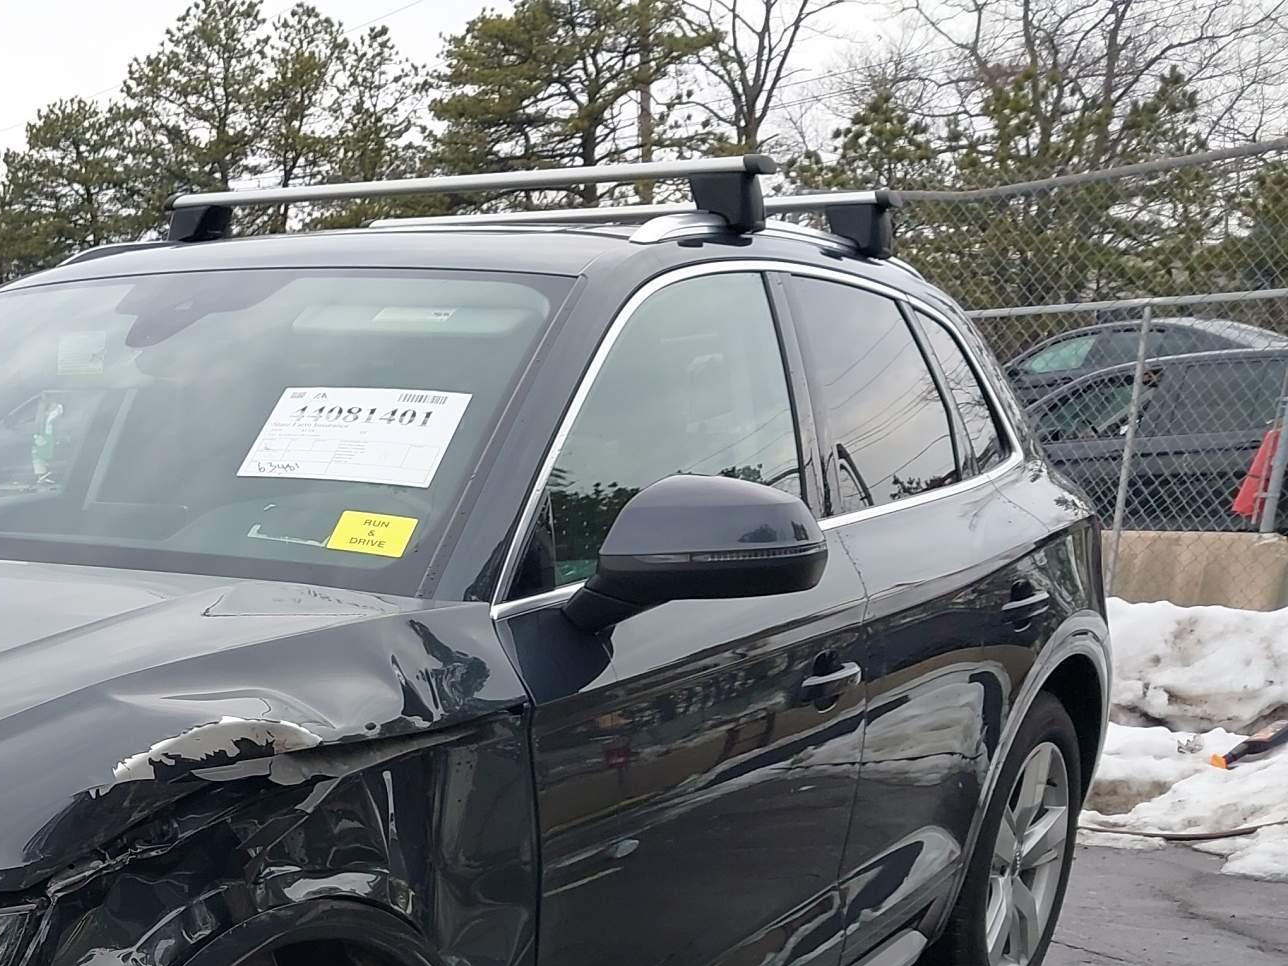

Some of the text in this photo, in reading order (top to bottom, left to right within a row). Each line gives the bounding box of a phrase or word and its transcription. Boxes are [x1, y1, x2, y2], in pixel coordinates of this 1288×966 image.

[289, 404, 434, 428] 44081401
[363, 518, 390, 528] RUN
[367, 529, 375, 537] &
[348, 536, 386, 548] DRIVE
